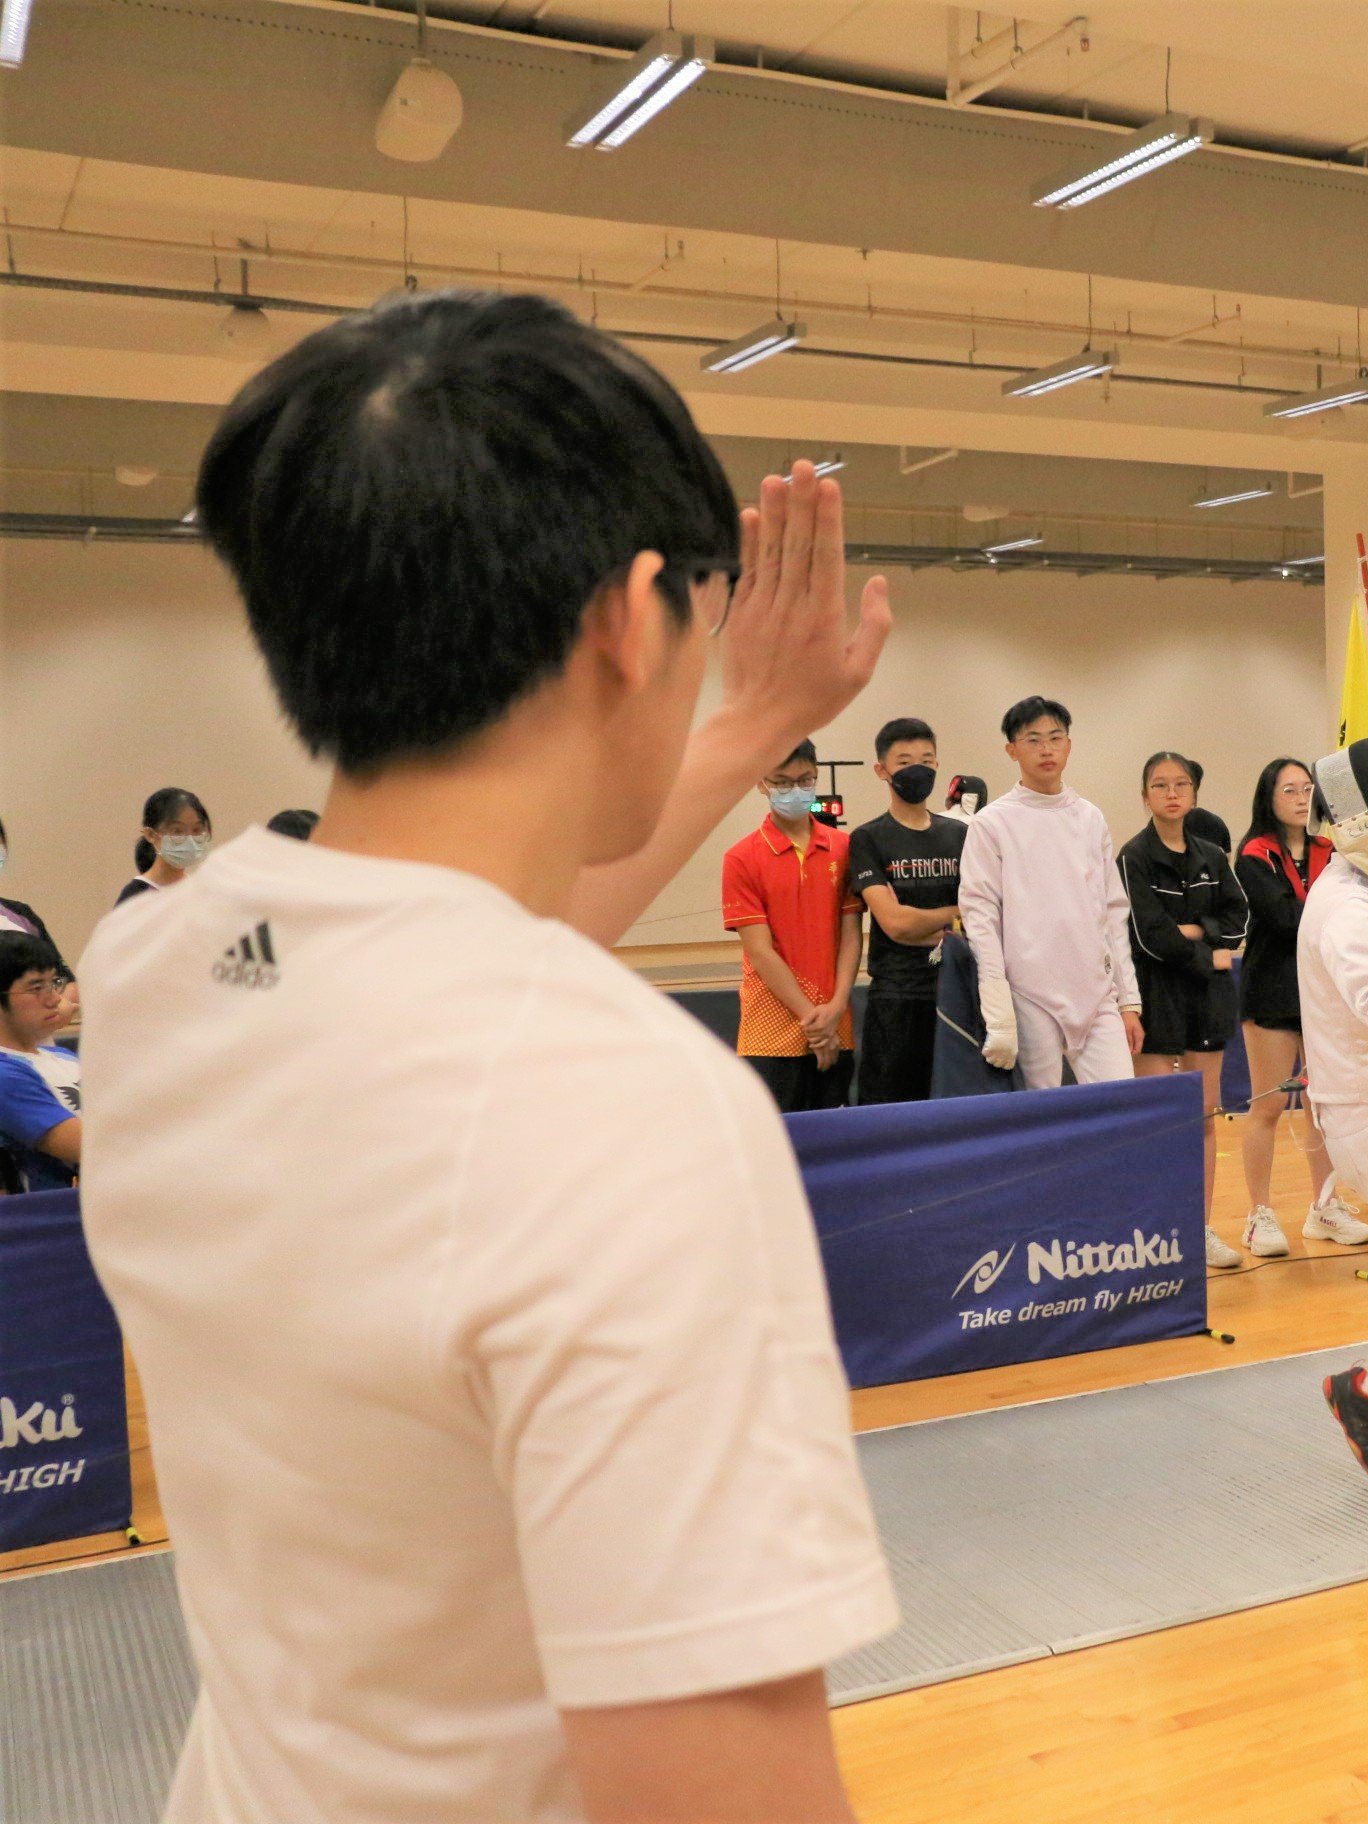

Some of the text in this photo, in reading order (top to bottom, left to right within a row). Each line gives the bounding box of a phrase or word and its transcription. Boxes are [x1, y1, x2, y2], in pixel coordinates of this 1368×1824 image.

[911, 858, 959, 878] FENCING
[1026, 1228, 1184, 1285] Nittaku
[958, 1278, 1184, 1330] Take dream fly HIGH
